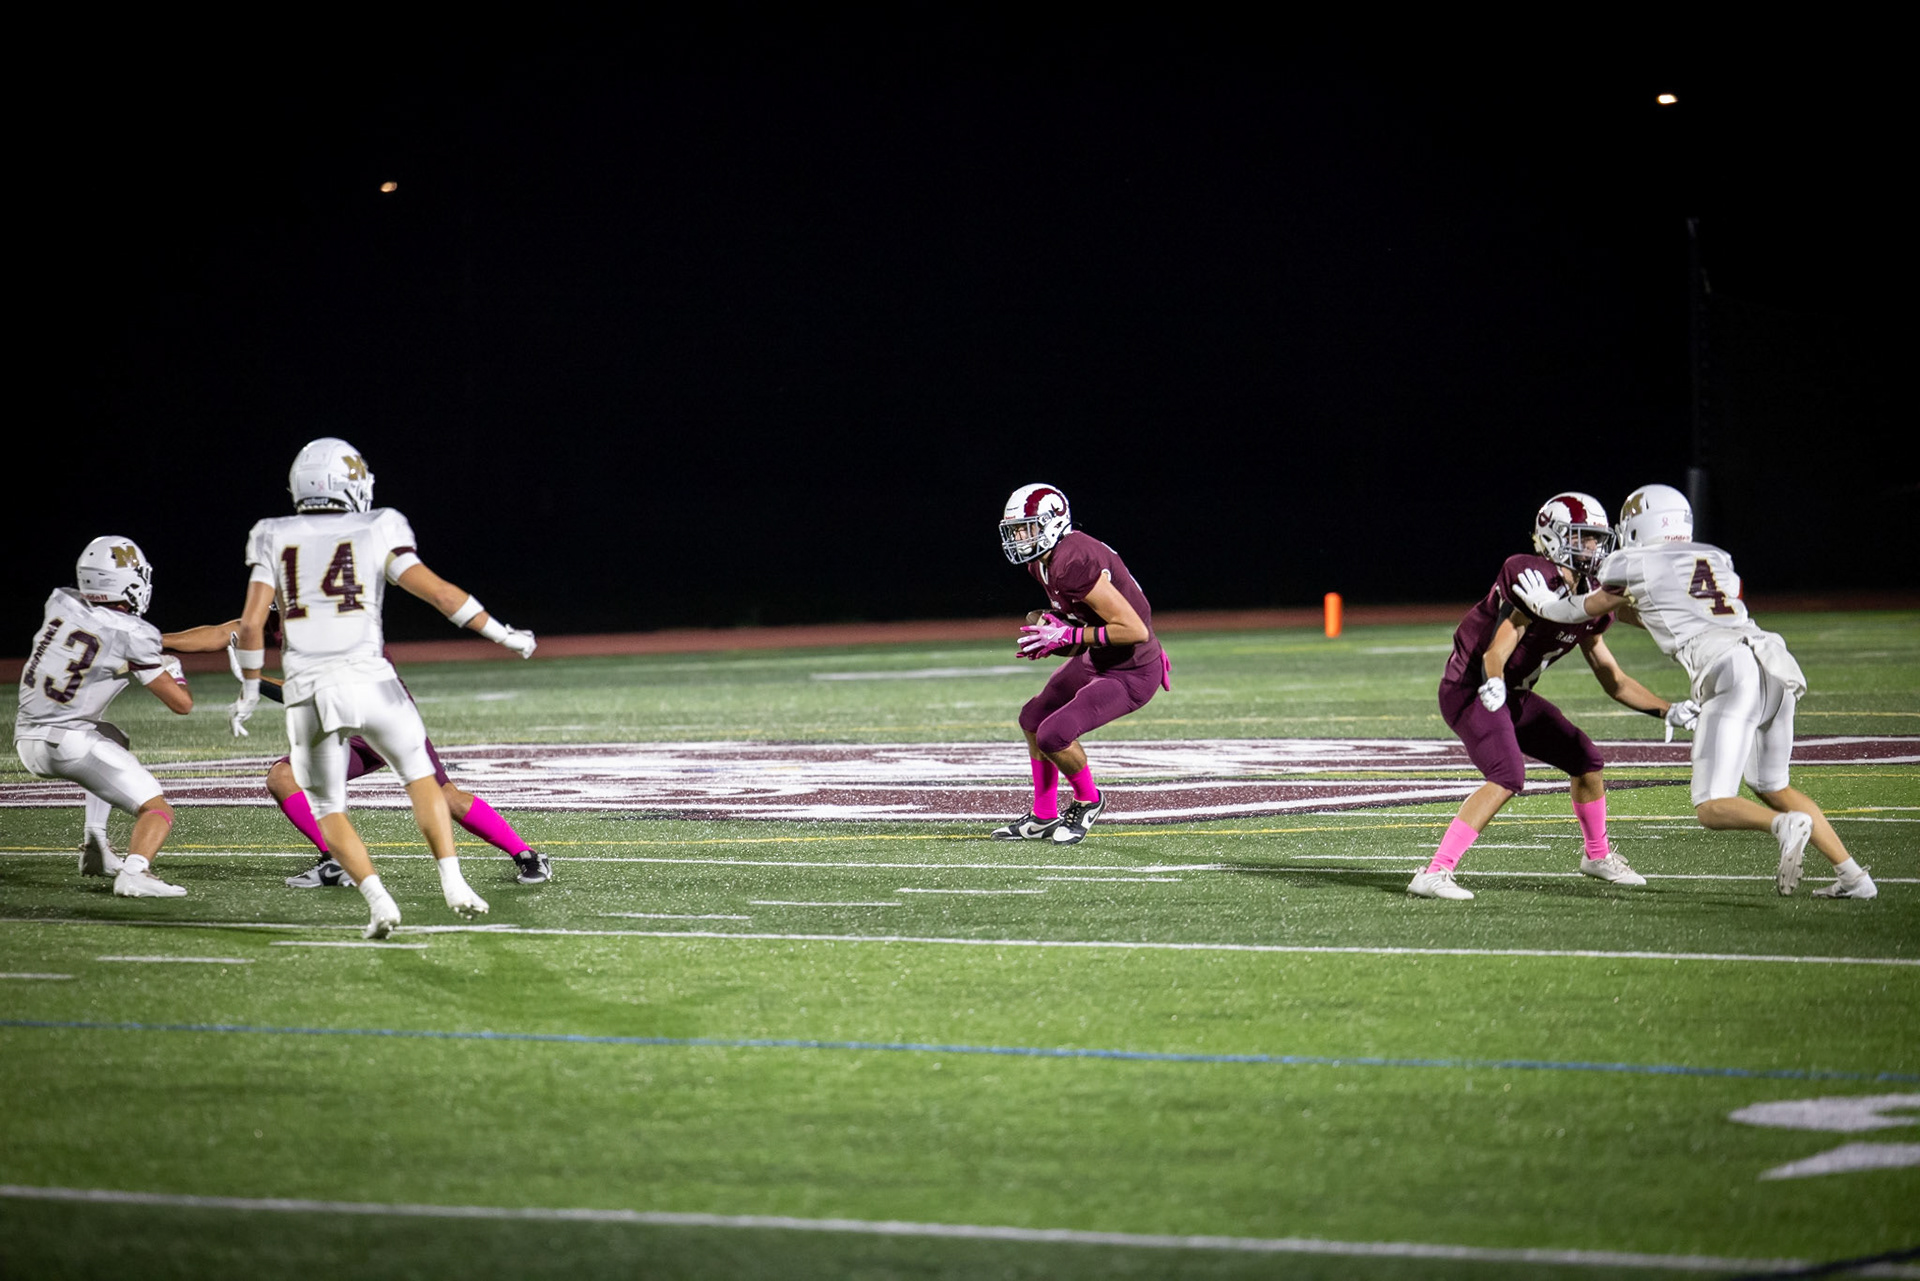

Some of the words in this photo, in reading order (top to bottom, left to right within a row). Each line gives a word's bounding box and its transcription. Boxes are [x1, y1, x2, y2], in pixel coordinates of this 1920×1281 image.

[341, 454, 366, 481] M
[109, 545, 139, 568] M
[280, 542, 364, 620] 14
[1688, 558, 1736, 616] 4
